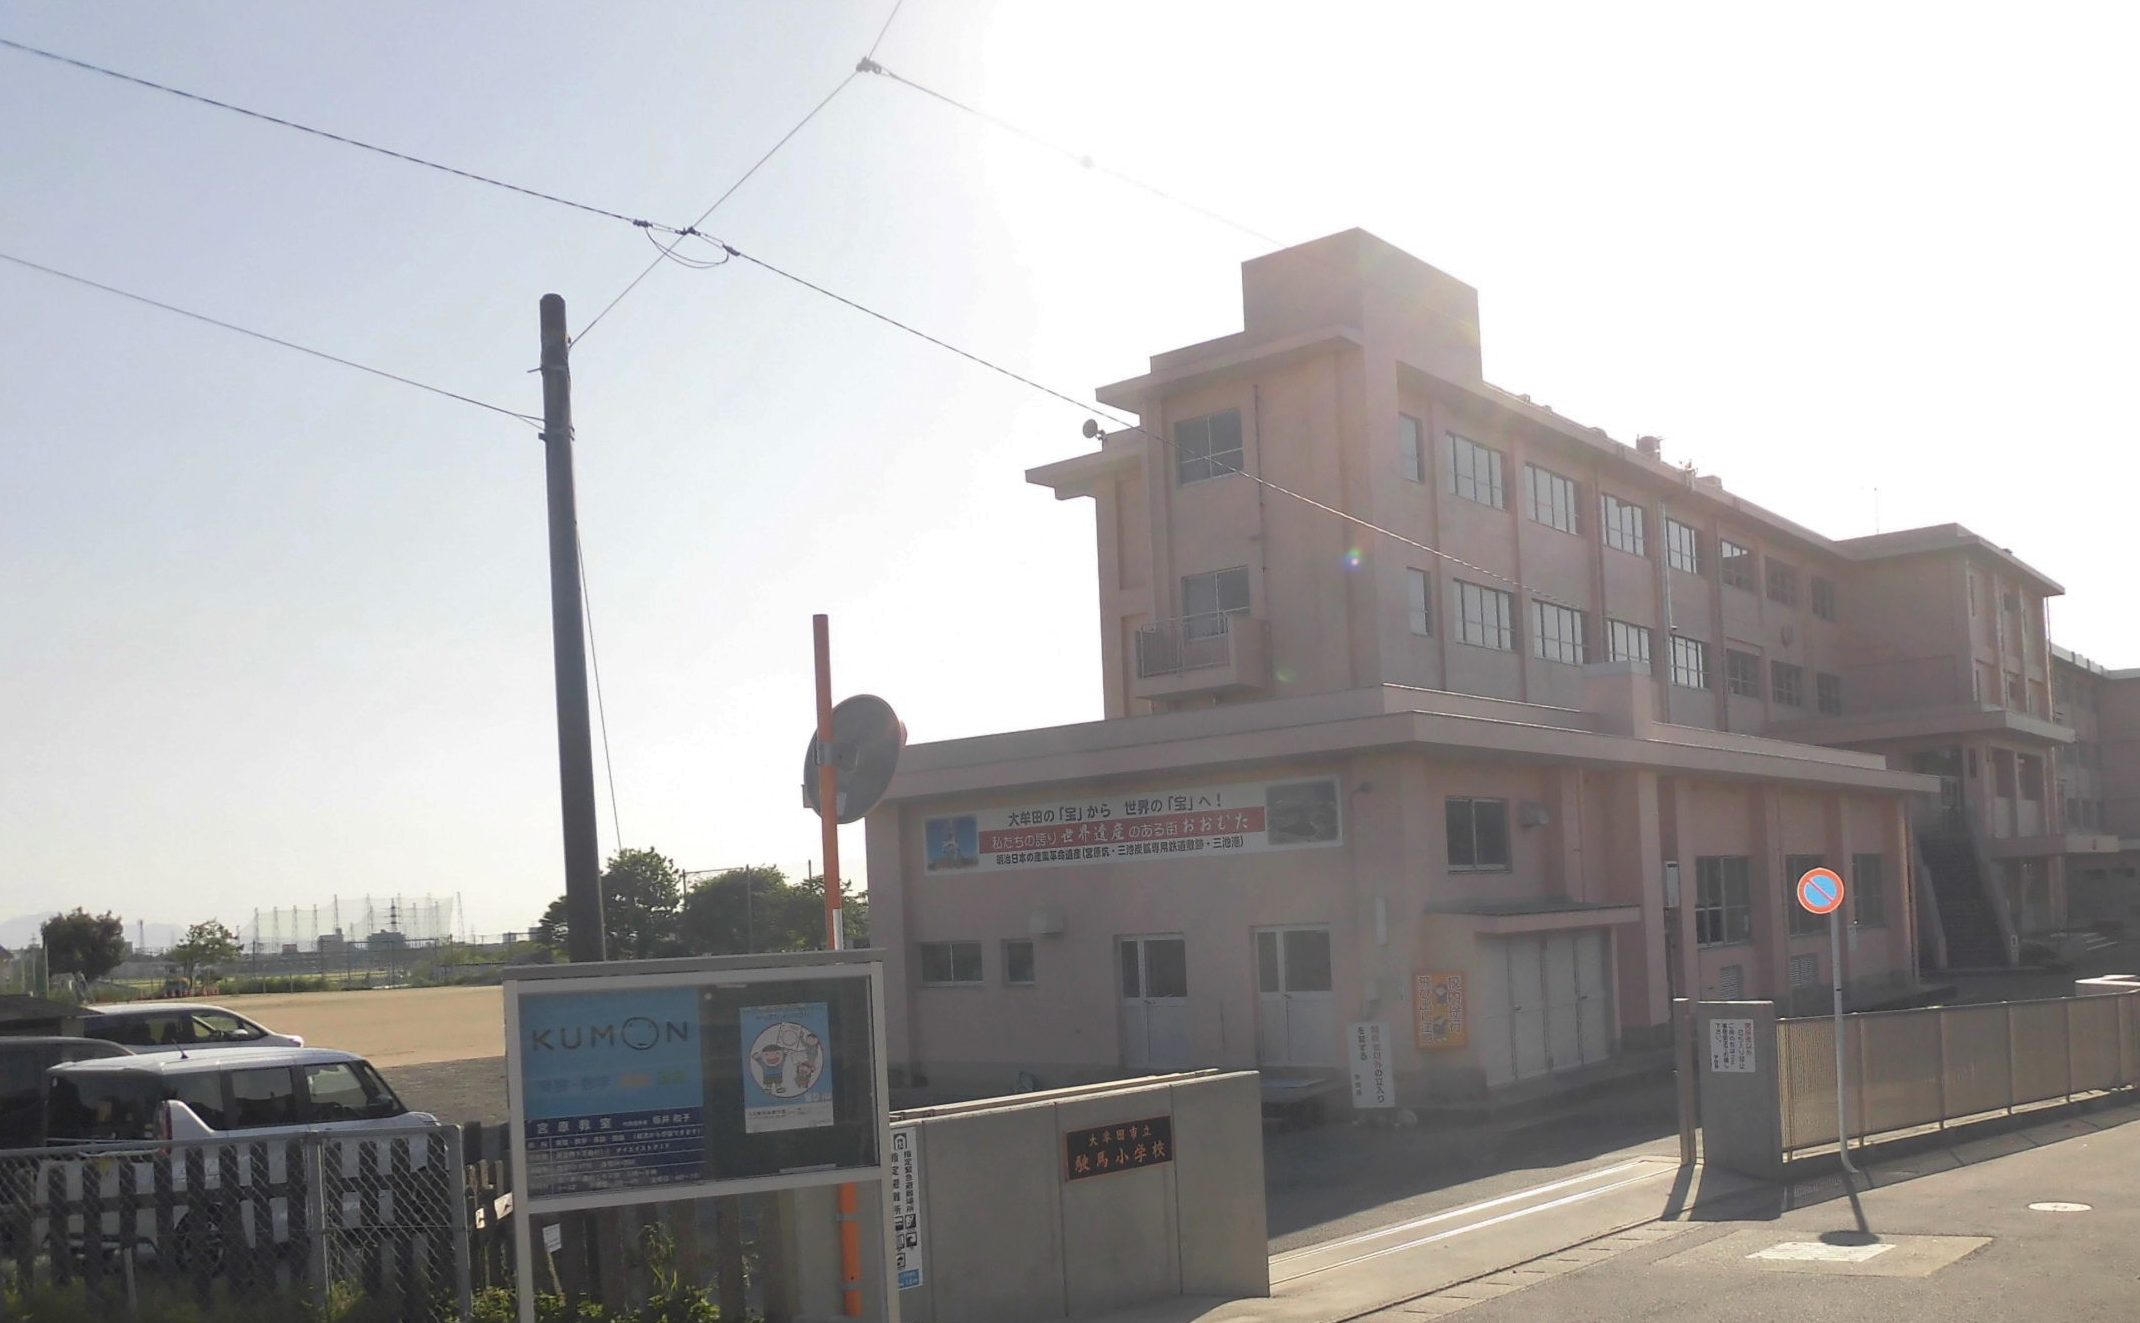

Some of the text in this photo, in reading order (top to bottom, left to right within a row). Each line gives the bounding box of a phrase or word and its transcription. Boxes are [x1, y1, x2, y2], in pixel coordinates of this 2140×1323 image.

[1008, 803, 1112, 827] 大牟田の「宝」から
[532, 1016, 688, 1051] KUMON
[1088, 1122, 1153, 1147] 大牟田市立
